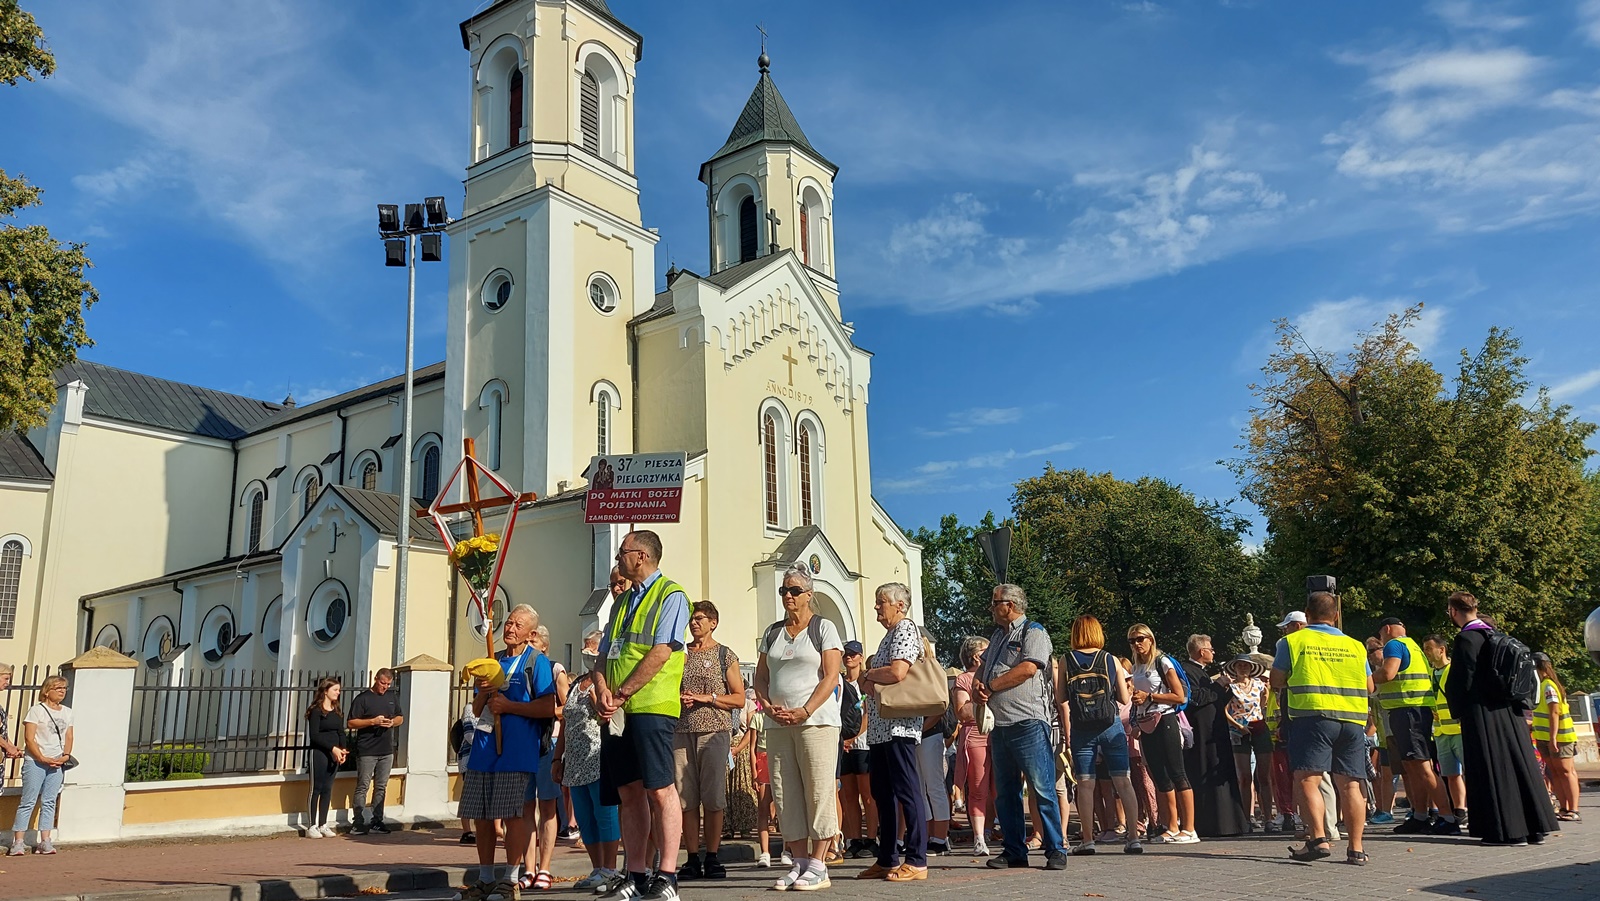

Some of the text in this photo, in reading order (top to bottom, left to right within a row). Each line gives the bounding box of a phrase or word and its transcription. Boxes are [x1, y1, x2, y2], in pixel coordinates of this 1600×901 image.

[644, 458, 682, 468] PIESZA
[616, 473, 681, 484] PIELGRZYMKA
[590, 488, 680, 500] DO MATKI BOŻEJ
[599, 500, 667, 509] POJEDNANIA
[588, 512, 625, 521] ZAMBRÓW
